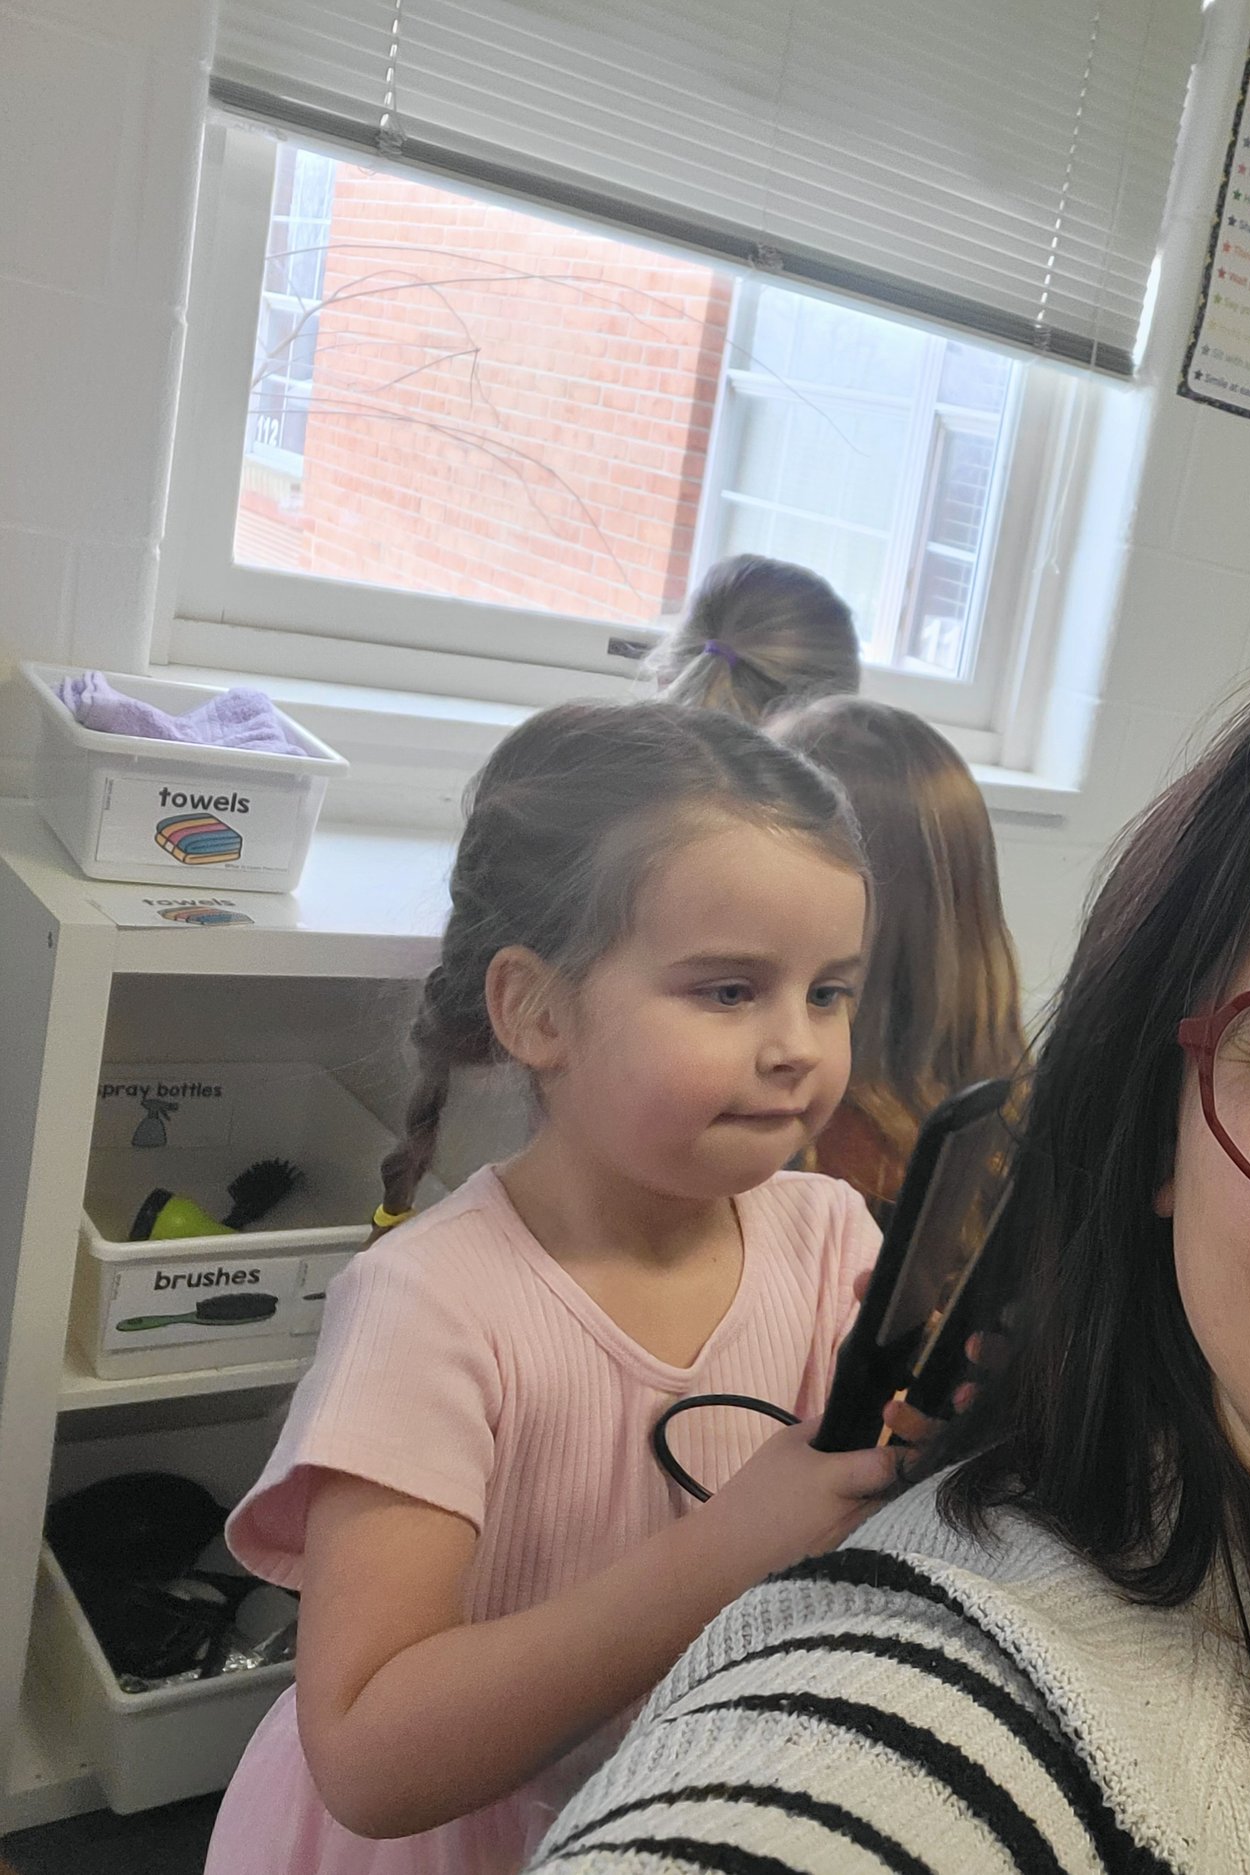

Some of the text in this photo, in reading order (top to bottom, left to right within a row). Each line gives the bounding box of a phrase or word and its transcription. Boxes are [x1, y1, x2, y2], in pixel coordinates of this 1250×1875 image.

[257, 415, 279, 447] 112
[158, 787, 251, 814] towels
[142, 898, 237, 907] towels
[157, 1082, 223, 1098] bottles
[153, 1267, 261, 1291] brushes
